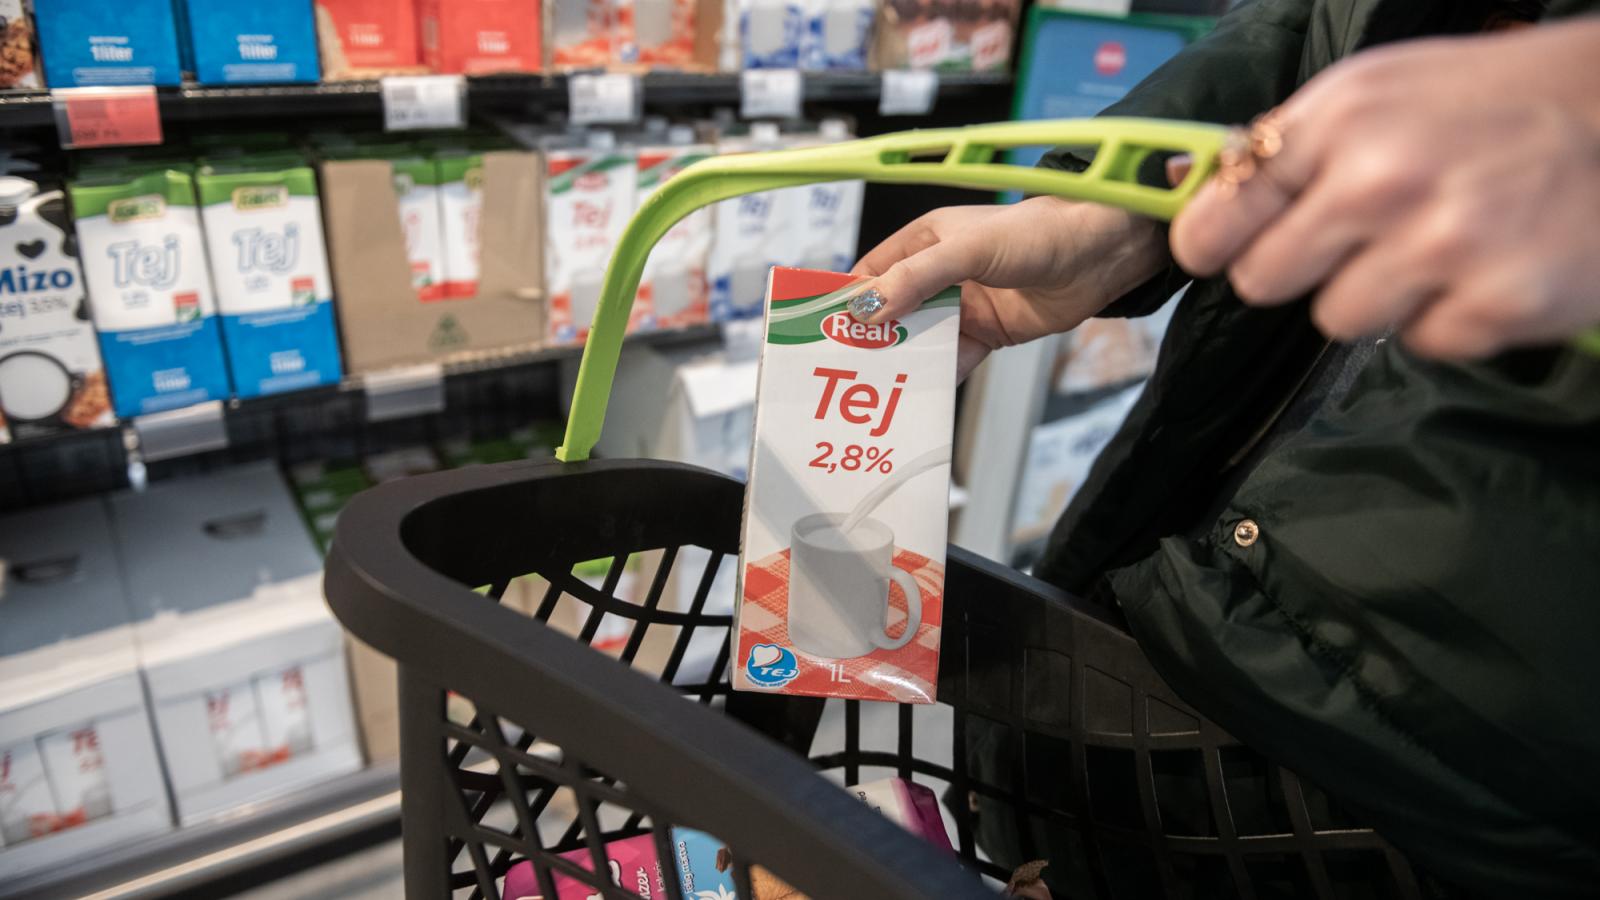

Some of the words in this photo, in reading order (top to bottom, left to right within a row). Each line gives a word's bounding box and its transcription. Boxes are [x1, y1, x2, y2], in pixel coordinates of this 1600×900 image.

[107, 233, 181, 290] Tej
[232, 222, 300, 275] Tej
[831, 313, 891, 343] Real
[813, 366, 909, 438] Tej
[808, 441, 895, 475] 2,8%
[760, 666, 799, 678] TEJ
[829, 662, 852, 684] 1L
